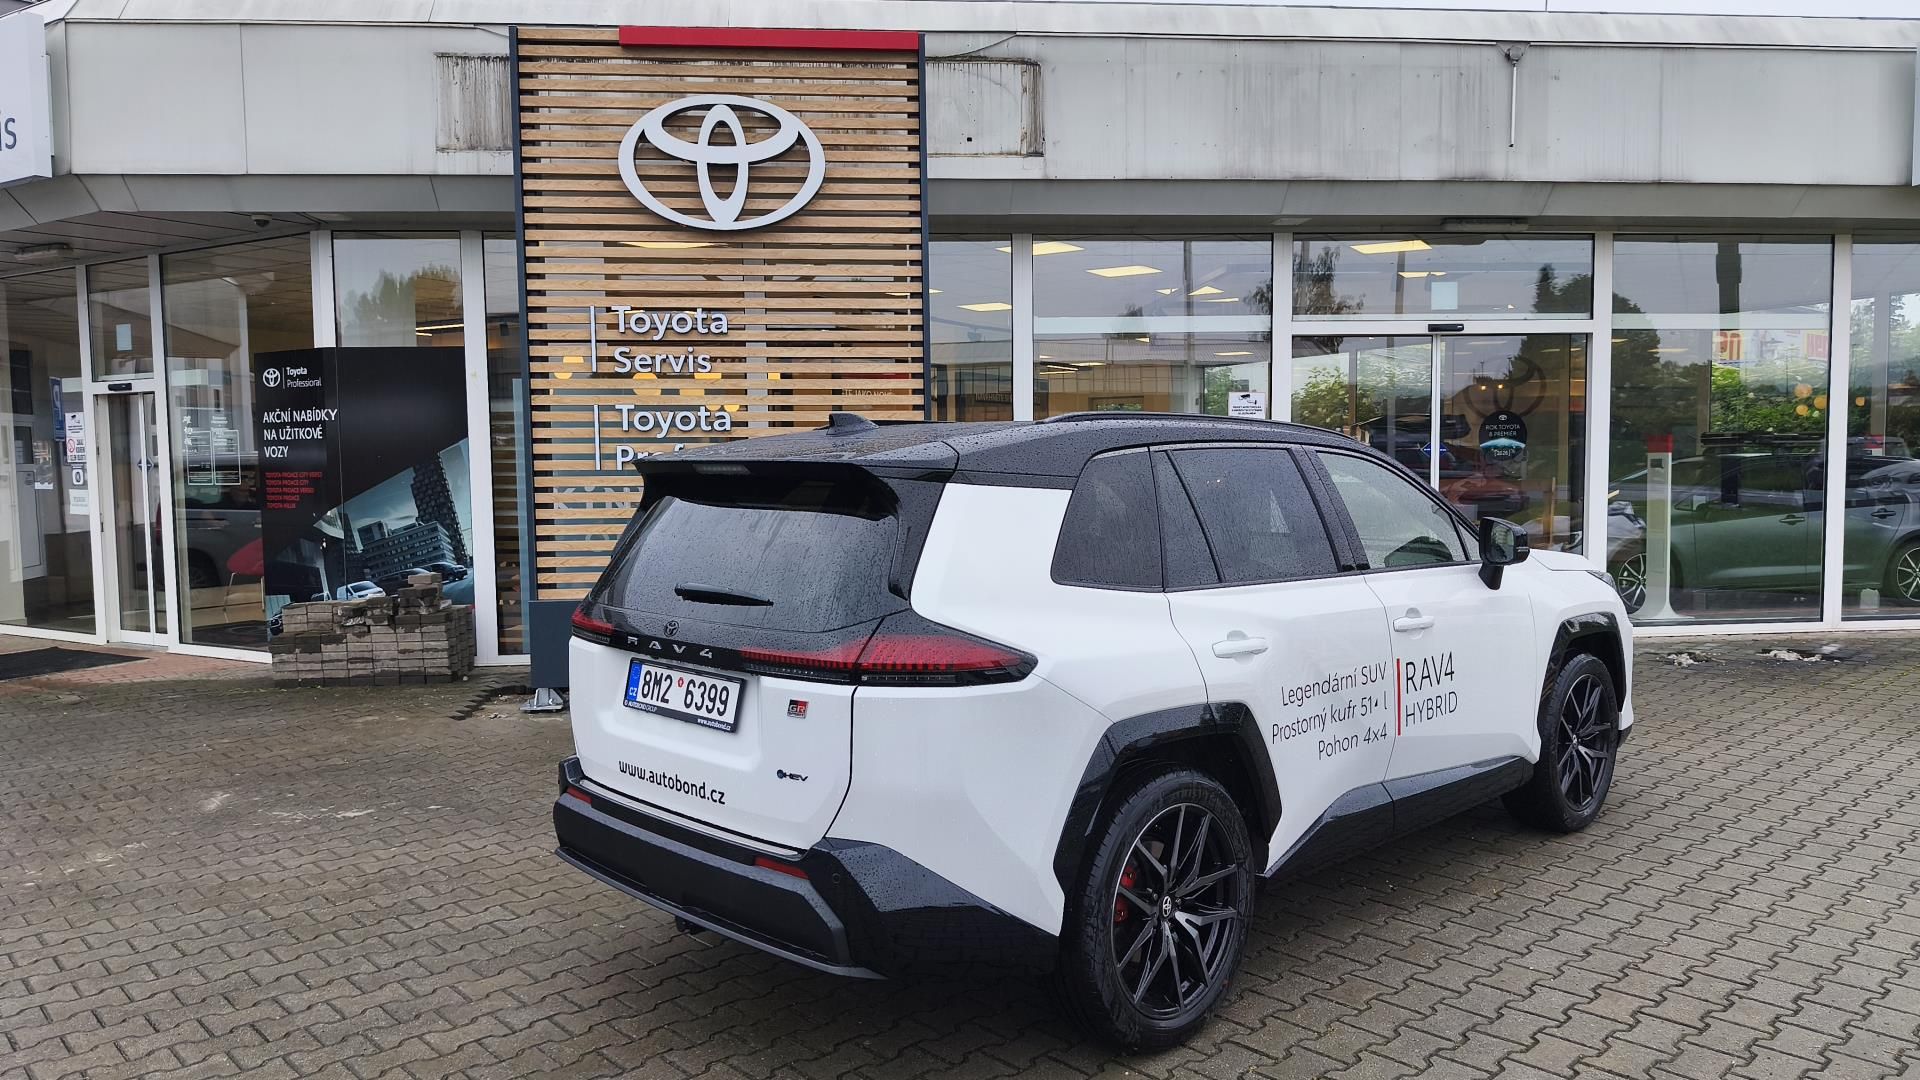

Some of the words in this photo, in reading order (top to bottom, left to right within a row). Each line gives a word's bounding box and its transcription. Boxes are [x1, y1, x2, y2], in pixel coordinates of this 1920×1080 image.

[611, 305, 729, 341] Toyota
[286, 366, 308, 377] Toyota
[614, 346, 712, 373] Servis
[287, 377, 322, 388] Professional
[262, 407, 291, 423] AKČNÍ
[293, 406, 338, 422] NABÍDKY
[263, 428, 277, 440] NA
[279, 424, 323, 440] UŽITKOVÉ
[615, 404, 732, 439] Toyota
[264, 445, 289, 458] VOZY
[627, 635, 713, 659] RAV4
[1281, 667, 1358, 707] Legendární
[1361, 661, 1387, 686] SUV
[1405, 651, 1455, 695] RAV4
[629, 686, 638, 696] CZ
[641, 669, 673, 704] 8M2
[683, 678, 730, 717] 6399
[1272, 701, 1327, 744] Prostorný
[1330, 698, 1358, 724] kufr
[1405, 691, 1458, 727] HYBRID
[1318, 733, 1359, 760] Pohon
[1363, 722, 1388, 745] 4x4
[618, 760, 726, 805] www.autobond.cz
